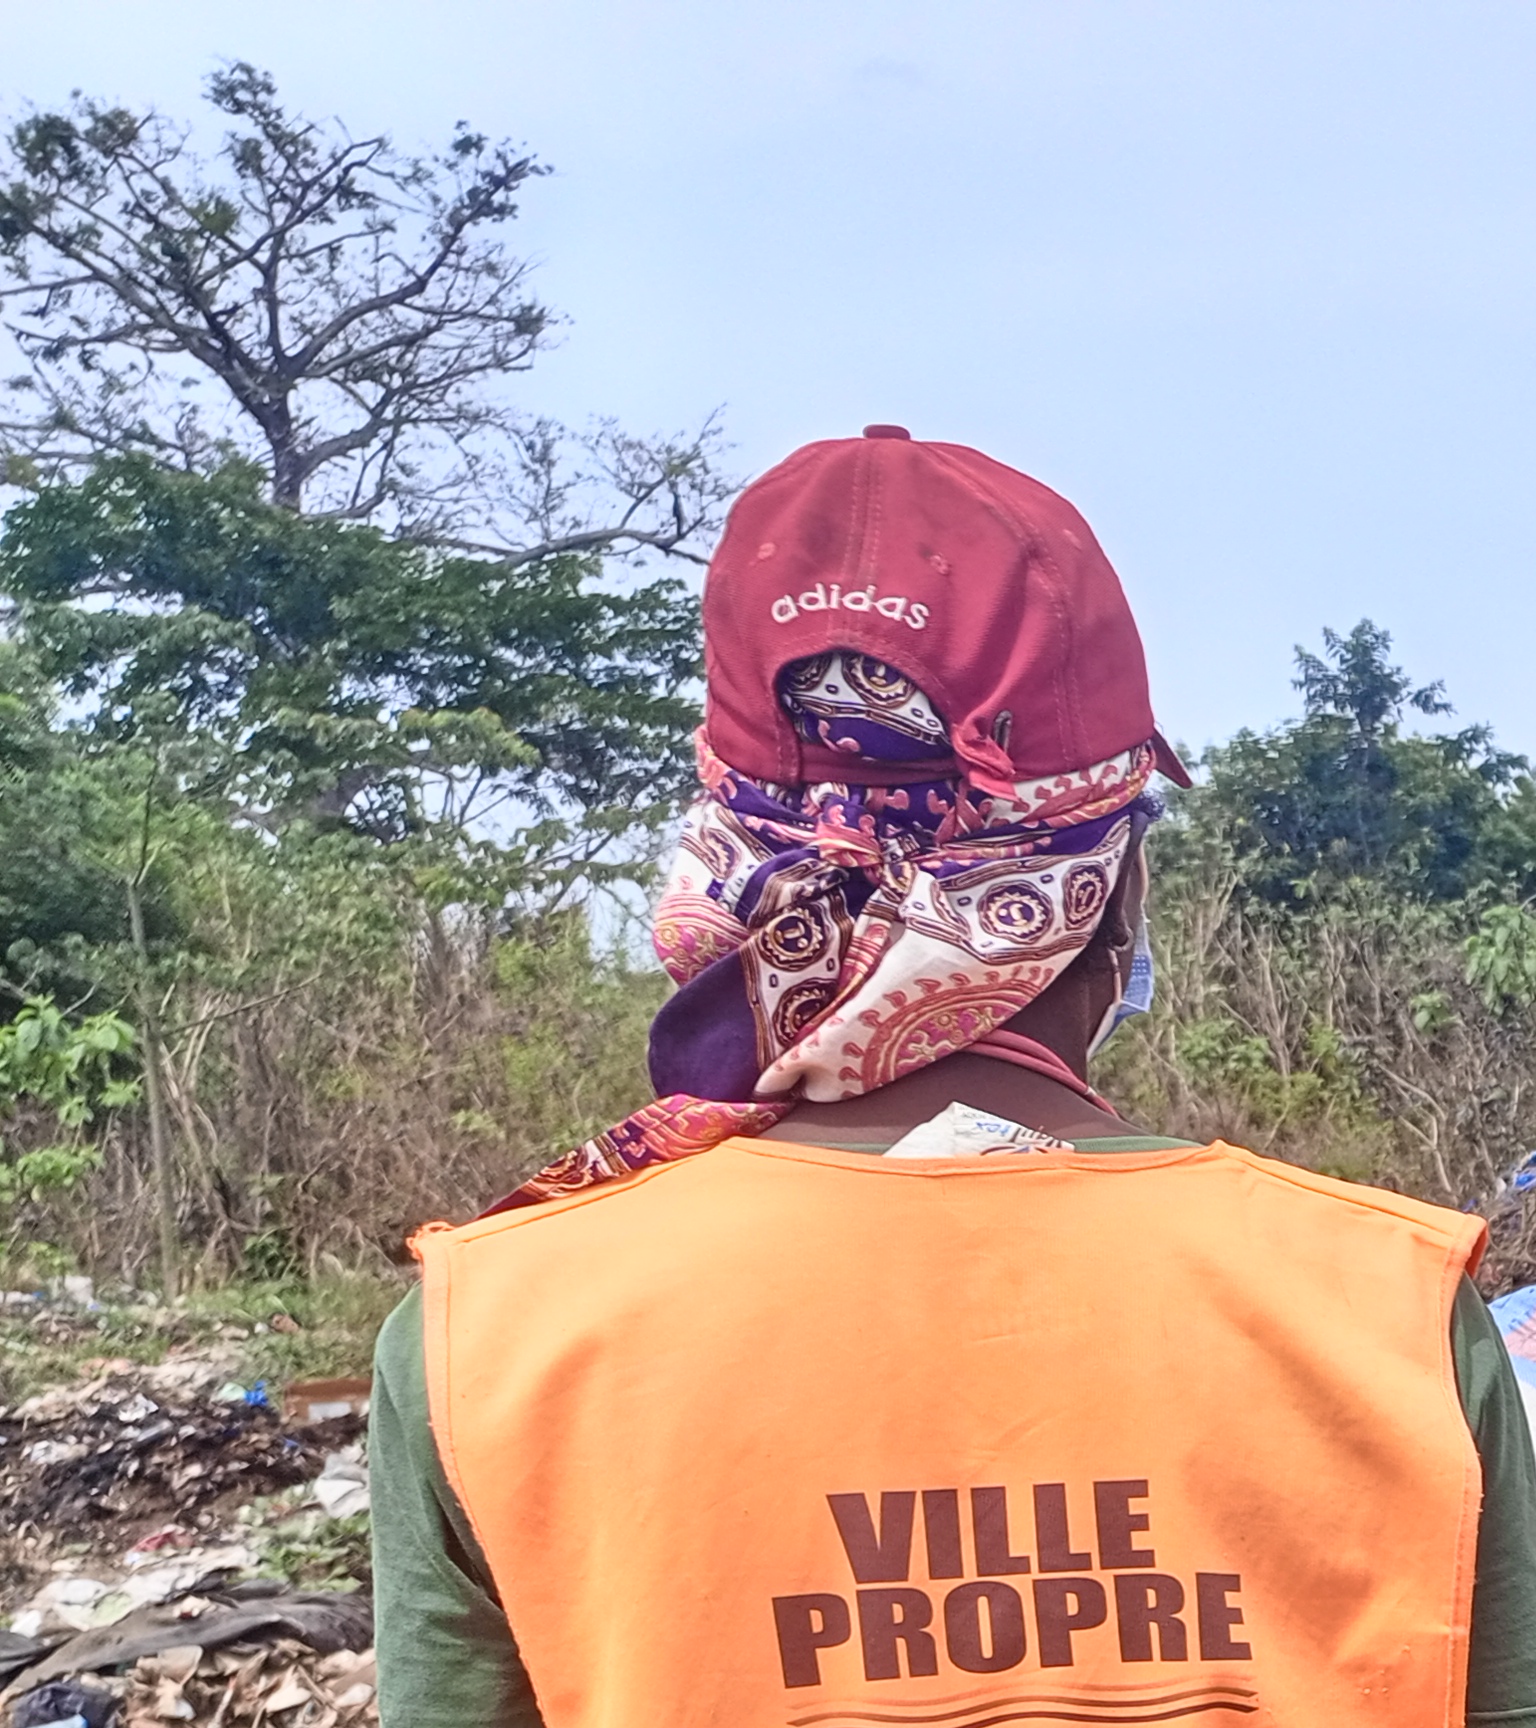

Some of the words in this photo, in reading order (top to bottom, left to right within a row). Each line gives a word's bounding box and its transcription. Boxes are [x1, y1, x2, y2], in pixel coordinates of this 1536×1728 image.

[771, 582, 930, 630] adidas
[827, 1480, 1155, 1583] VILLE
[772, 1573, 1252, 1689] PROPRE
